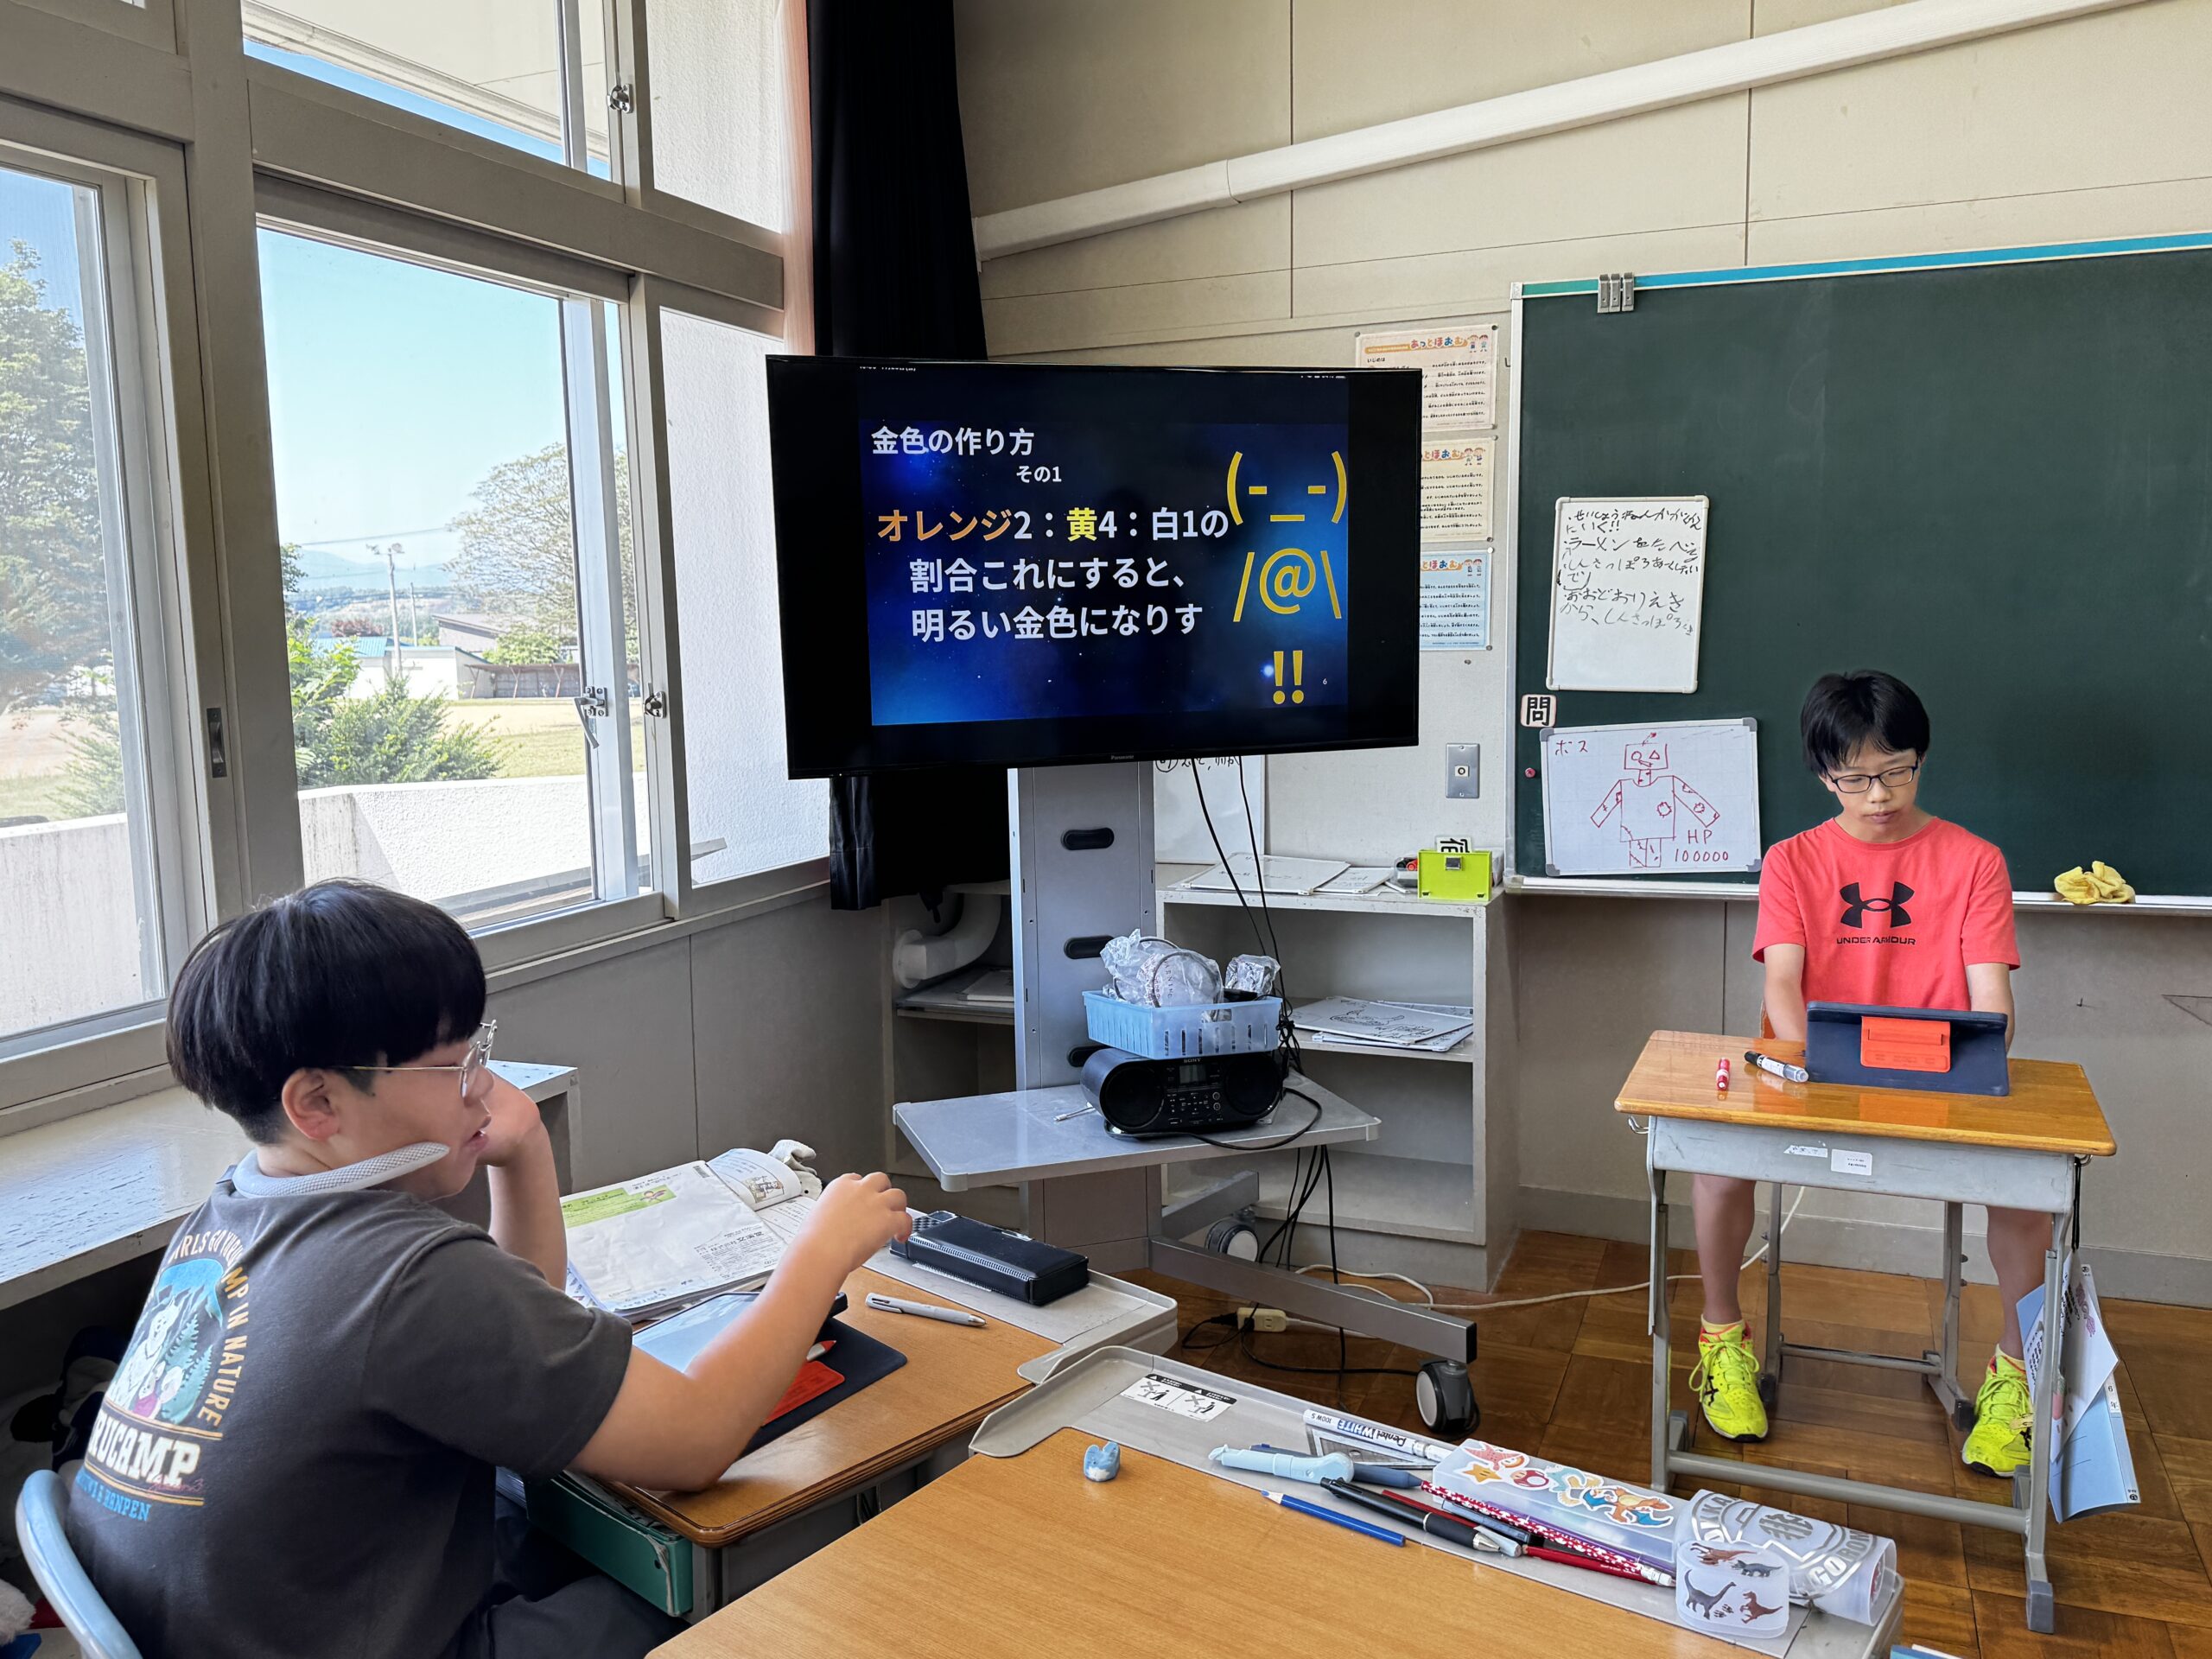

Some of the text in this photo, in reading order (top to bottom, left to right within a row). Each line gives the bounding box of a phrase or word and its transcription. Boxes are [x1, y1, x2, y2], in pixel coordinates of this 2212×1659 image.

[1410, 336, 1464, 349] あっとほおむ
[871, 426, 1035, 455] 金色の作り方
[1016, 465, 1062, 483] その1
[909, 557, 1185, 594] 割合これにすると、
[912, 603, 1203, 643] 明るい金色になりす
[1526, 696, 1551, 726] 問
[1555, 740, 1588, 757] ボス
[1688, 830, 1713, 844] HP
[1675, 849, 1729, 862] 100000
[1872, 936, 1916, 944] ARMOUR
[227, 1302, 249, 1330] IN
[197, 1335, 248, 1427] NATURE
[1338, 1419, 1374, 1439] WHITE
[1376, 1430, 1407, 1447] Pentel
